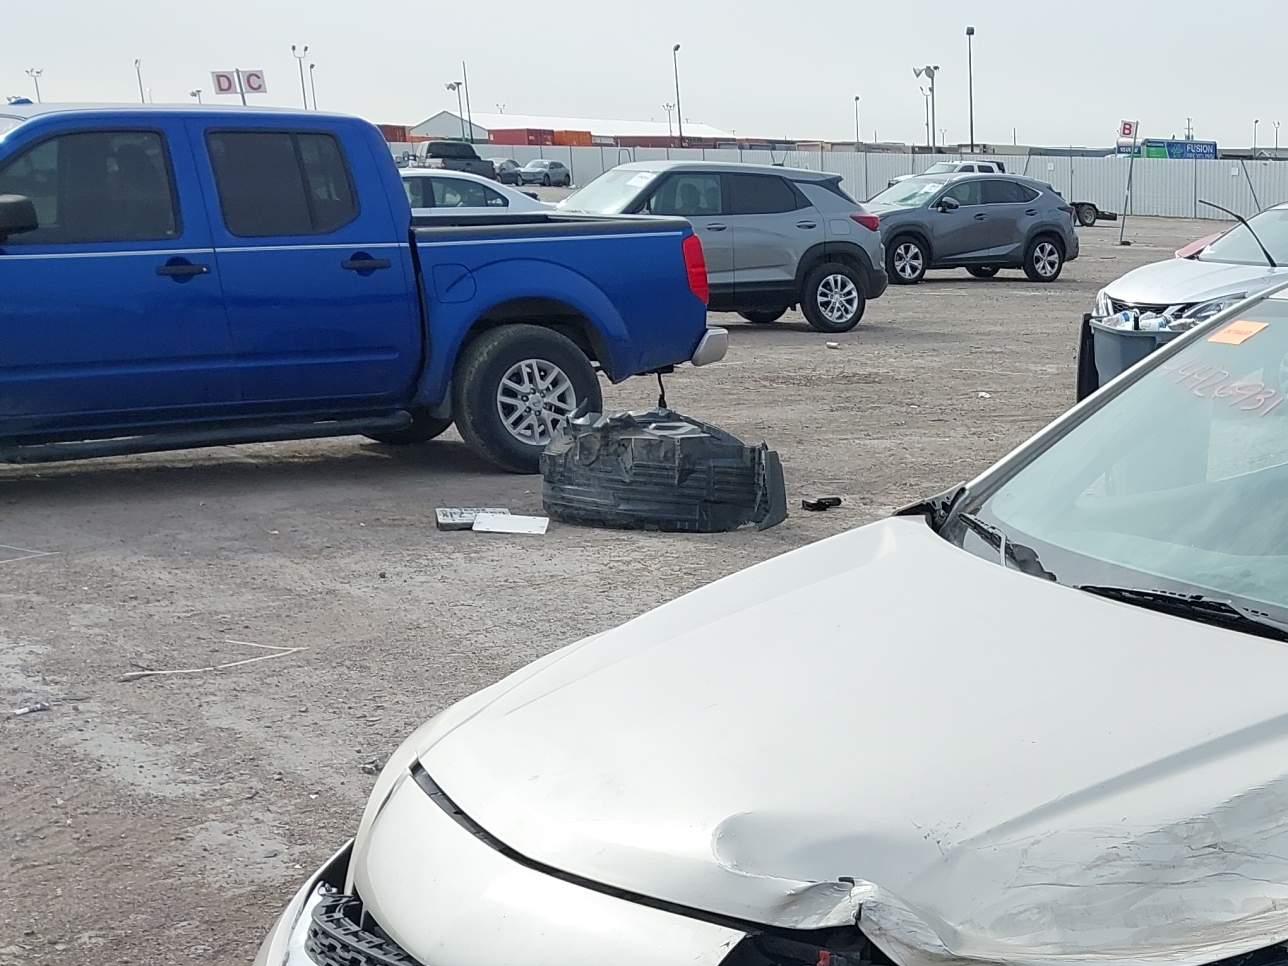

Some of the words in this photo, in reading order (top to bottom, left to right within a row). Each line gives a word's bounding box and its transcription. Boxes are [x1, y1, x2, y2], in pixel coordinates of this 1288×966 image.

[215, 74, 232, 91] D
[246, 73, 262, 90] C
[1122, 122, 1132, 136] B
[1186, 143, 1214, 153] FUSION
